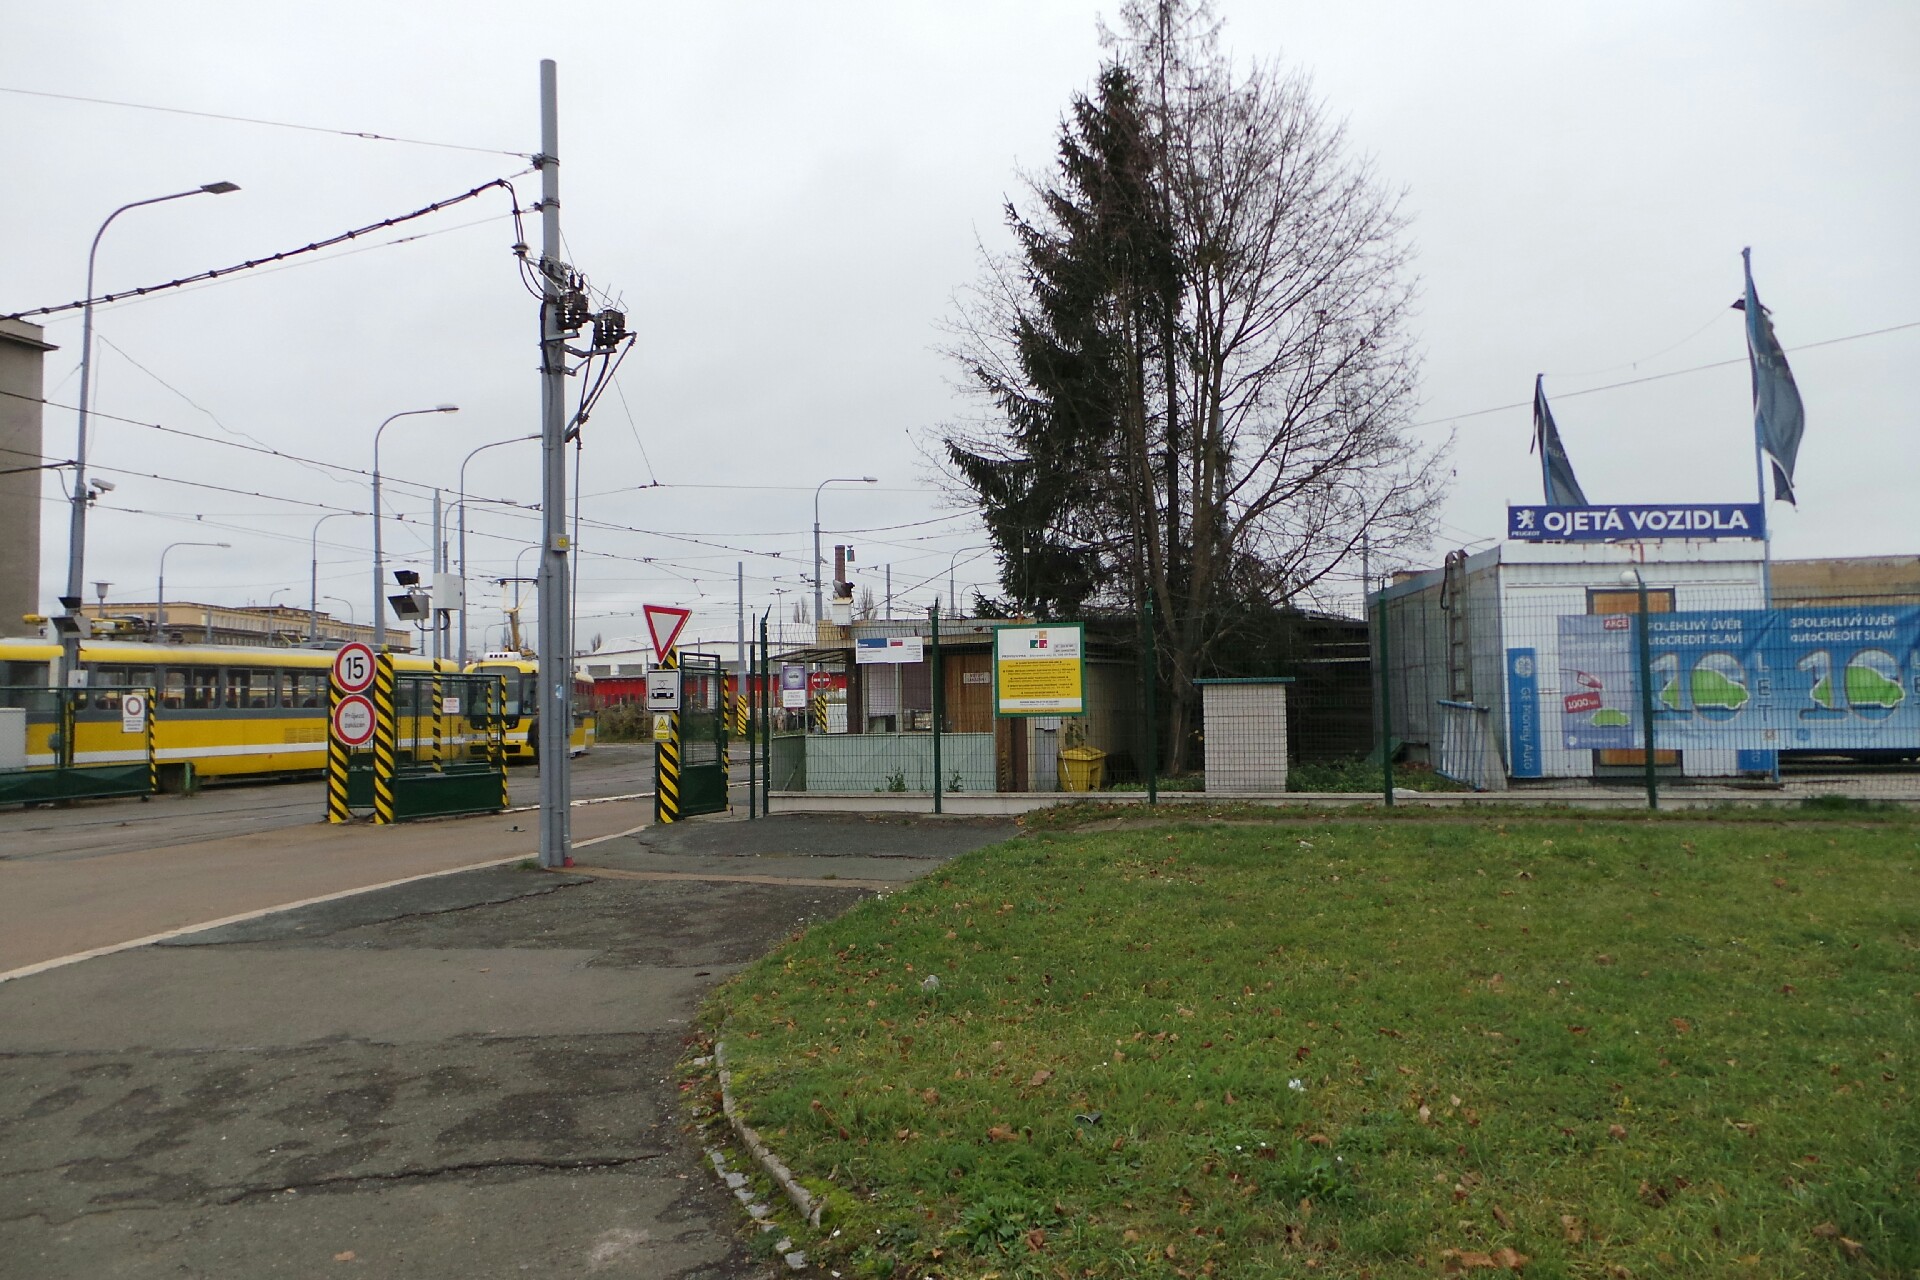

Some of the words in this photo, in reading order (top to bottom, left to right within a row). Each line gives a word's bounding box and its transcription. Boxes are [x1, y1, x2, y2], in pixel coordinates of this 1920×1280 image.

[1543, 508, 1624, 535] OJETÁ
[1628, 509, 1749, 531] VOZIDLA
[1646, 618, 1708, 632] POLEHLIVÝ
[1711, 617, 1742, 631] ÚVĚR
[1790, 613, 1862, 629] SPOLEHLIVÝ
[1865, 613, 1896, 626] ÚVĚR
[1646, 633, 1706, 646] utoCREDIT
[1709, 631, 1743, 645] SLAVÍ
[1791, 630, 1862, 643] autoCREDIT
[1864, 628, 1897, 641] SLAVÍ
[345, 656, 364, 680] 15
[1568, 698, 1589, 710] 1000
[1523, 743, 1535, 770] Auto
